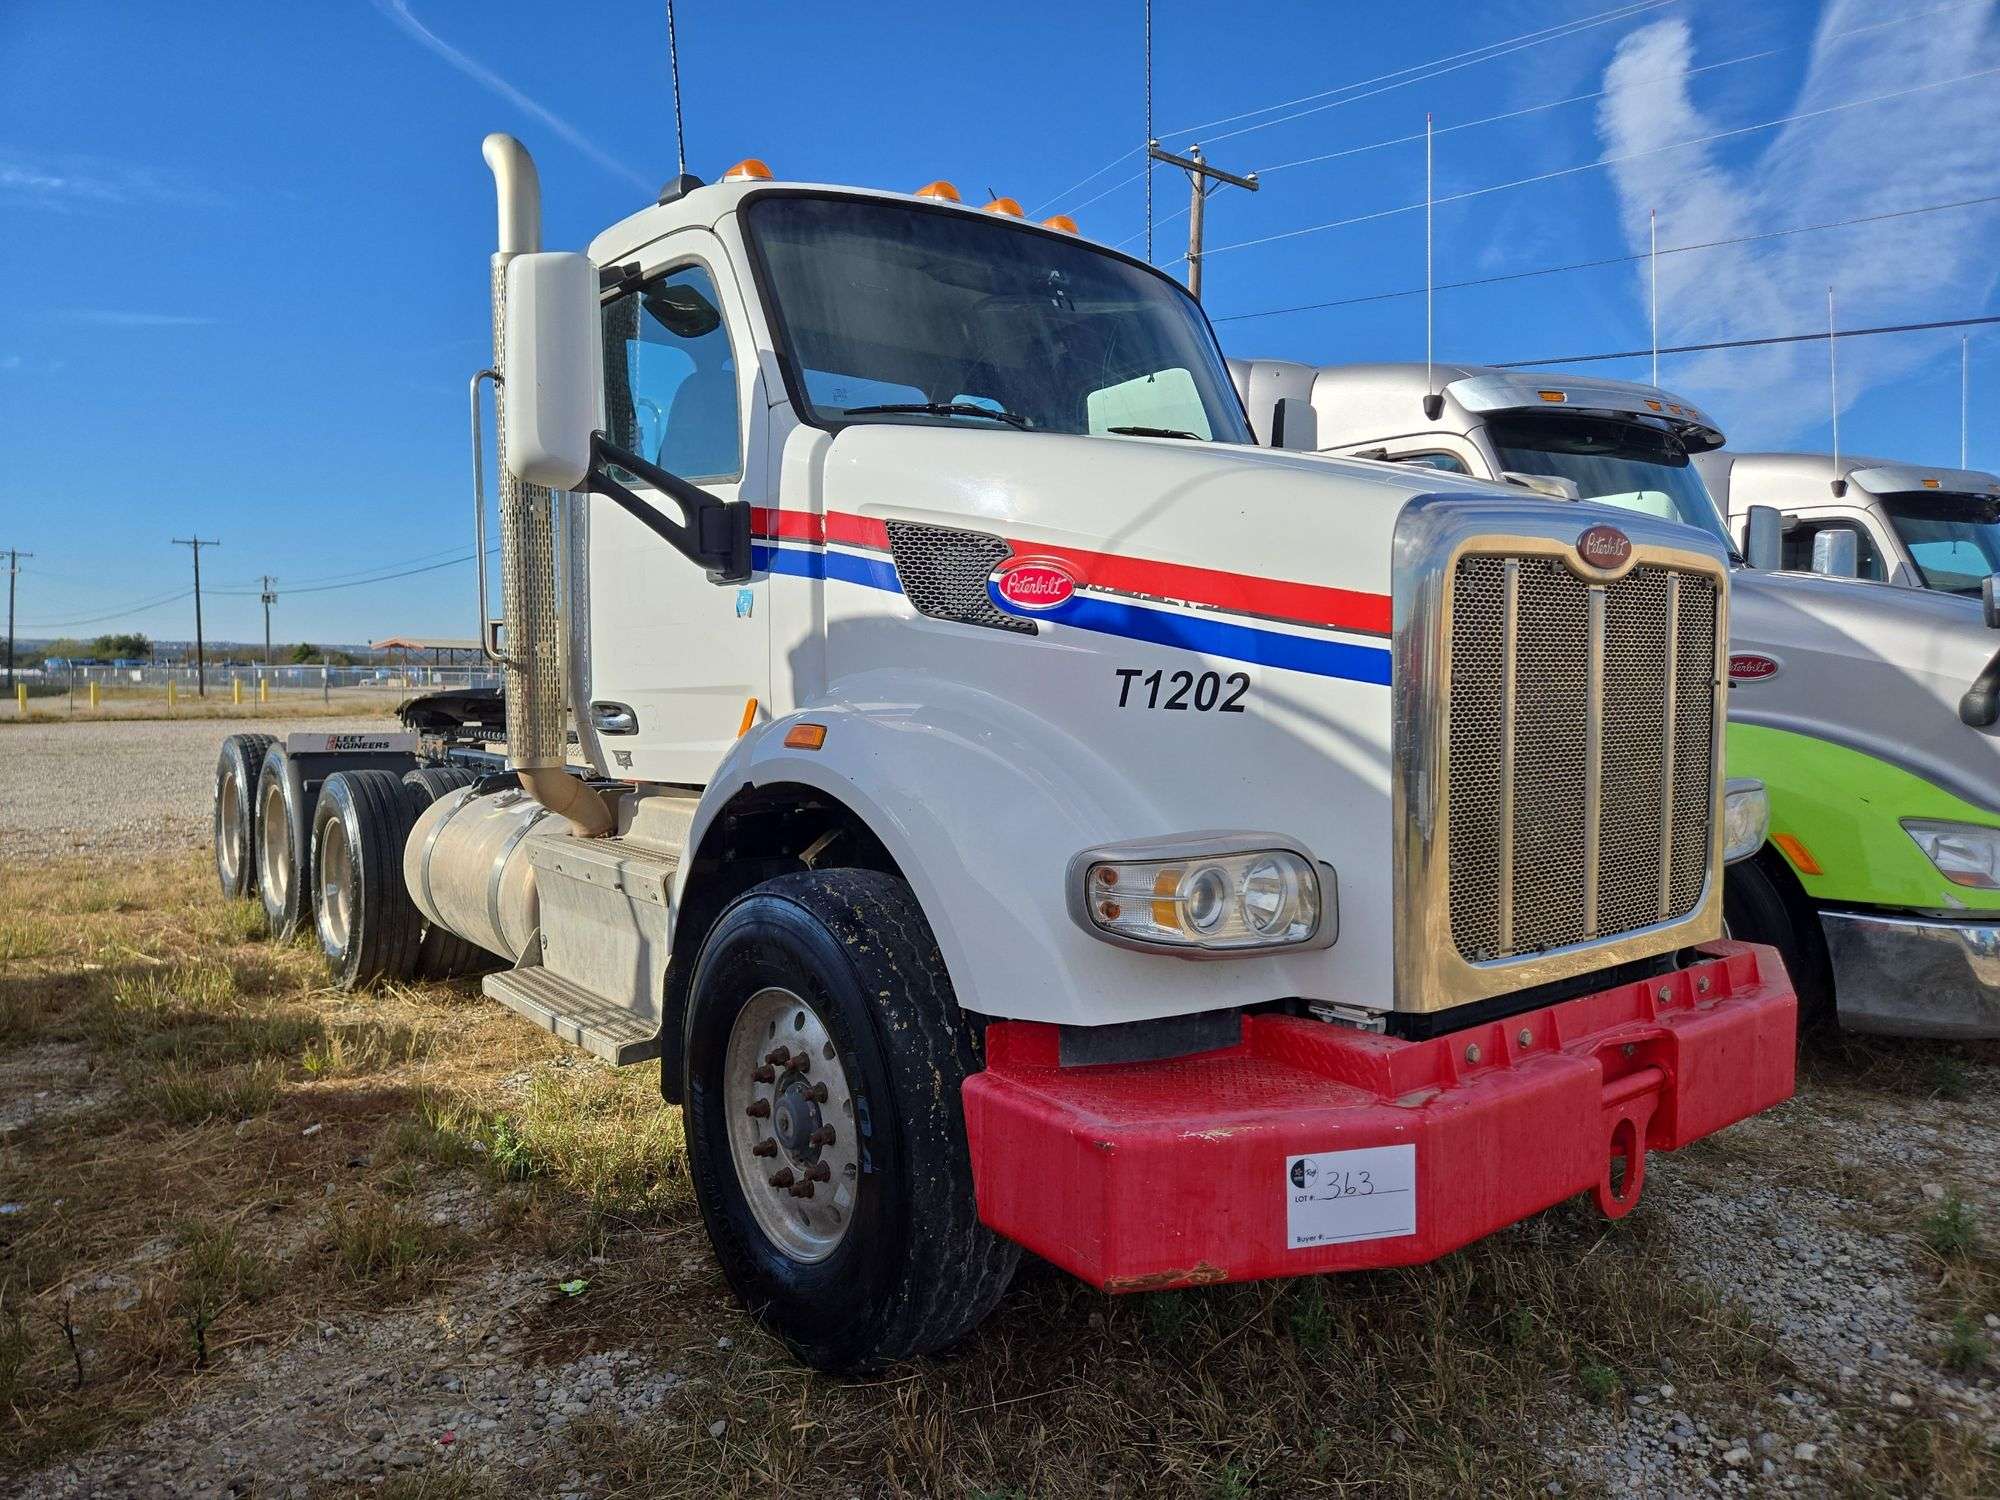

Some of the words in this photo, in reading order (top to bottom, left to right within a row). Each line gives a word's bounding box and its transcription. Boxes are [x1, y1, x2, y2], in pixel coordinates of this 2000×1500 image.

[1586, 532, 1629, 556] Peterbilt
[1007, 571, 1067, 595] Peterbilt
[1728, 661, 1771, 673] eterbilt
[1115, 669, 1250, 713] T1202
[1295, 1195, 1307, 1203] LOT
[1326, 1171, 1374, 1200] 363
[1296, 1235, 1316, 1243] Buyer
